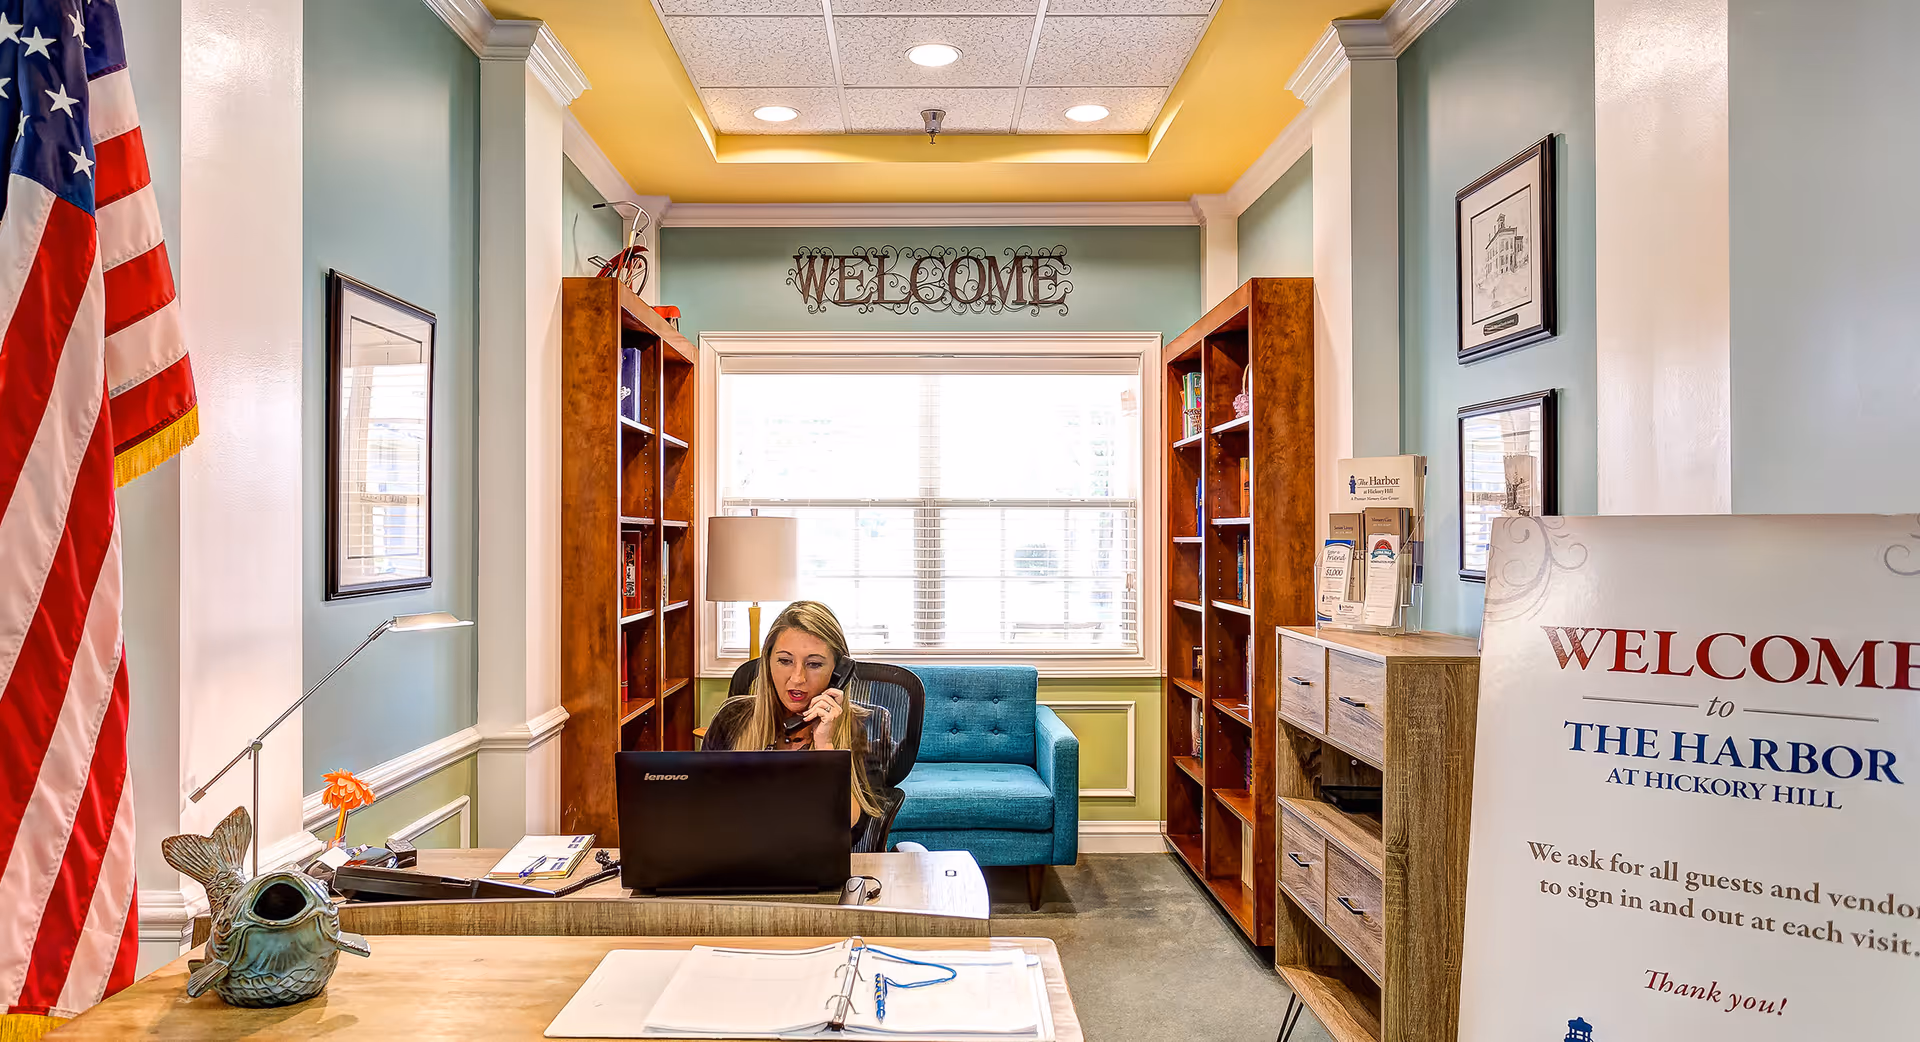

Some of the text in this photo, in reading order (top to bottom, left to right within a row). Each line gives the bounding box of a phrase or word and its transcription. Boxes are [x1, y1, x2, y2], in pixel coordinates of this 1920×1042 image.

[790, 252, 1067, 307] WELCOME
[1369, 475, 1400, 486] Harbor
[1326, 568, 1344, 577] $1,000
[1540, 625, 1920, 691] WELCOME
[1705, 695, 1735, 718] to
[1563, 720, 1904, 784] THE HARBOR
[644, 772, 689, 781] lenovo
[1605, 767, 1843, 810] AT HICKORY HILL
[1527, 841, 1562, 864] We
[1567, 850, 1604, 870] ask
[1609, 853, 1645, 877] for
[1649, 860, 1679, 882] all
[1685, 868, 1764, 896] guests
[1770, 882, 1820, 904] and
[1539, 879, 1920, 957] to sign in and out at each visit.
[1644, 969, 1788, 1017] Thank you!
